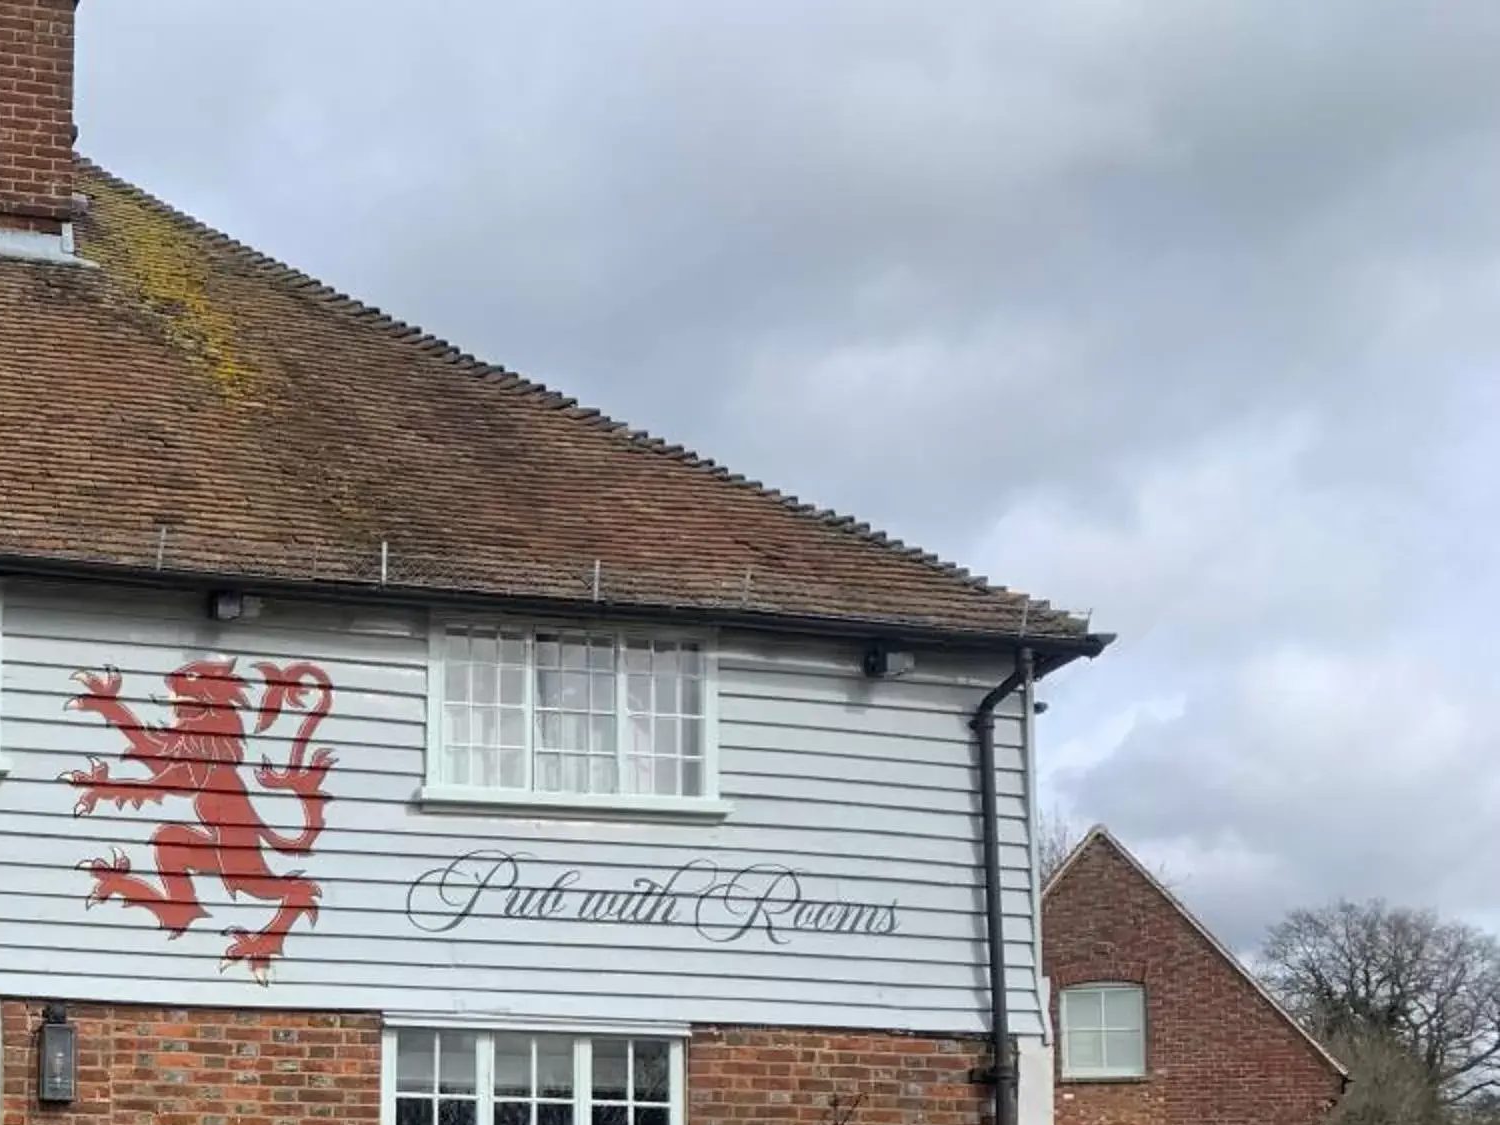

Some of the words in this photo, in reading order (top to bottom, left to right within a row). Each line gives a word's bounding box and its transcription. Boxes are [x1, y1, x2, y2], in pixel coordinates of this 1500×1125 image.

[406, 848, 582, 932] Pub
[576, 858, 718, 925] with
[695, 863, 900, 944] Rooms
